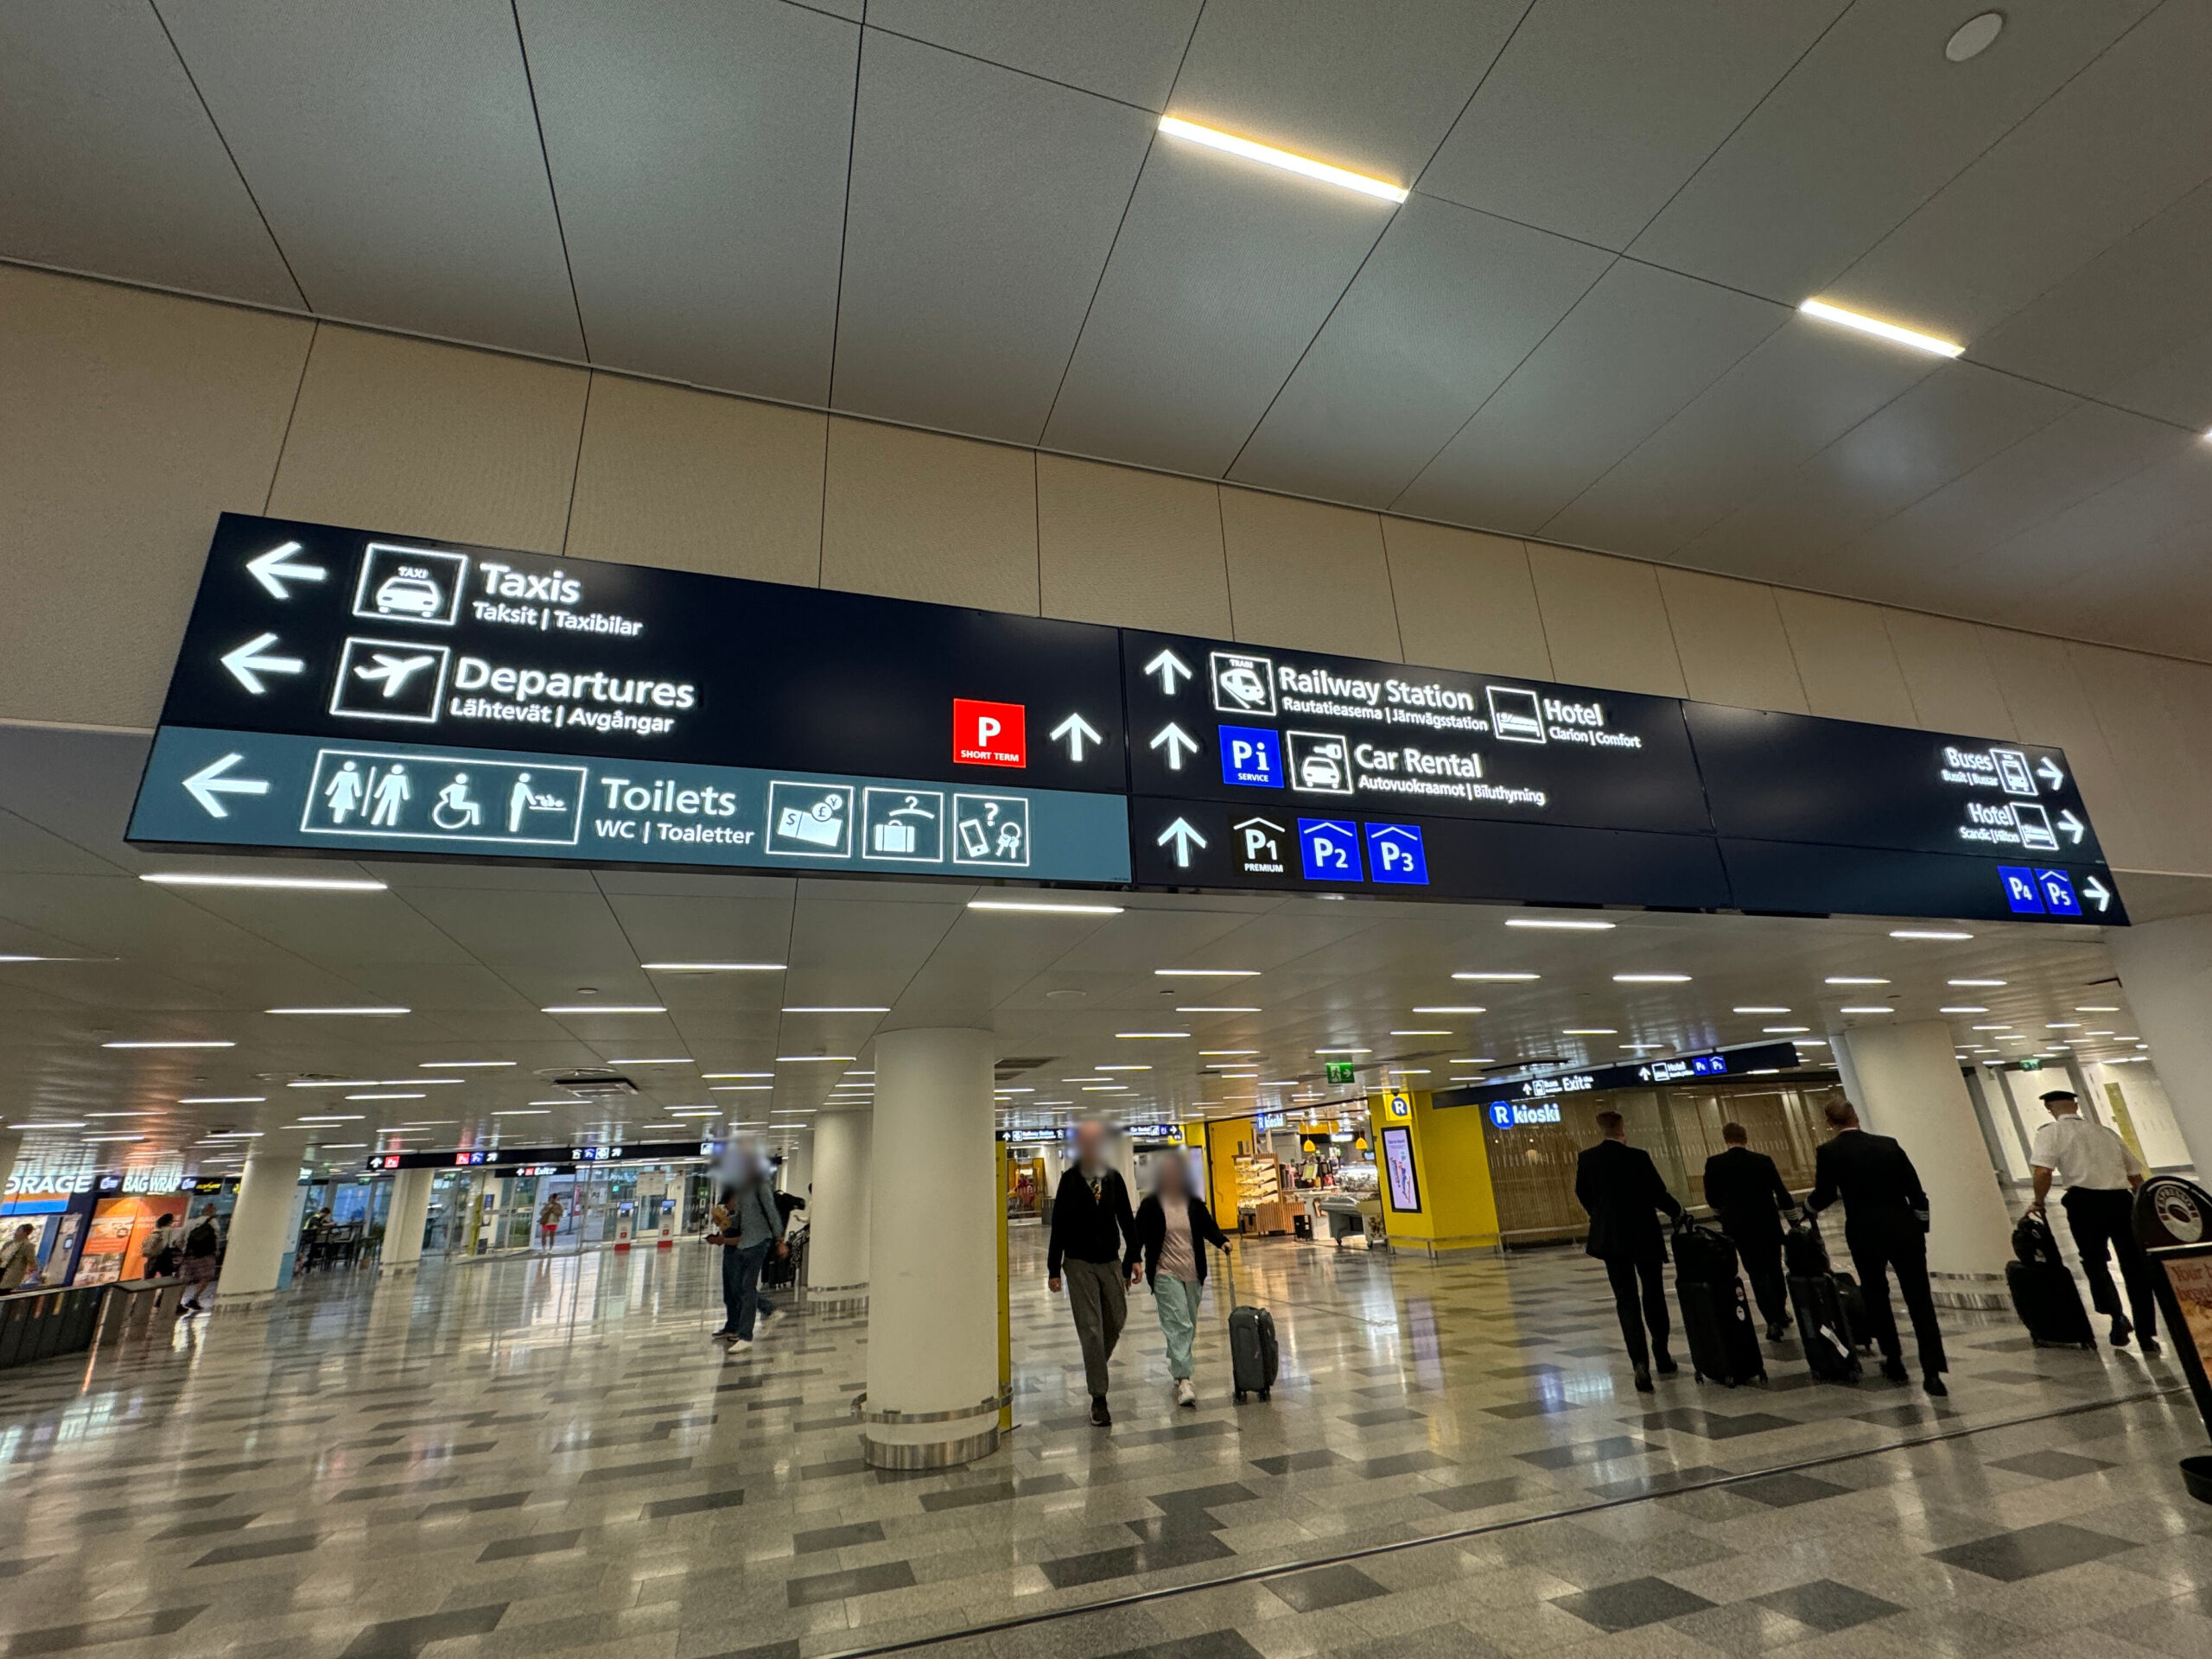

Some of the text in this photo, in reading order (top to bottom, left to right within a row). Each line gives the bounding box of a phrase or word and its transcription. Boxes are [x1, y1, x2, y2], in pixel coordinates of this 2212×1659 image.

[398, 566, 429, 578] TAXI
[480, 563, 582, 604] Taxis
[473, 601, 538, 626] Taksit
[554, 610, 644, 636] Taxibilar
[1230, 658, 1254, 669] TRAIN
[454, 657, 695, 708] Departures
[1278, 667, 1474, 711] Railway Station
[450, 697, 552, 722] Lähtevät
[568, 708, 675, 734] Avgångar
[1282, 697, 1382, 720] Rautatieasema
[1393, 709, 1489, 732] Järnvägsstation
[1543, 698, 1605, 727] Hotel
[978, 716, 1001, 747] P
[1549, 727, 1589, 742] Clarion
[1595, 731, 1643, 748] Comfort
[961, 749, 1020, 762] SHORT TERM
[1354, 743, 1482, 778] Car Rental
[1944, 746, 1994, 772] Buses
[1237, 772, 1269, 783] SERVICE
[1357, 774, 1465, 797] Autovuokraamot
[1473, 784, 1546, 806] Biluthyrning
[601, 778, 737, 816] Toilets
[1967, 802, 2014, 826] Hotel
[594, 819, 635, 838] WC
[657, 823, 755, 844] Toaletter
[1245, 829, 1278, 861] P1
[1313, 837, 1348, 868] P2
[1380, 842, 1414, 873] P3
[1244, 862, 1284, 874] PREMIUM
[2009, 877, 2032, 900] P4
[2046, 882, 2071, 906] P5
[1562, 1076, 1585, 1092] Exit
[1393, 1100, 1406, 1115] R
[1494, 1103, 1560, 1124] R kioski
[122, 1175, 149, 1192] BAG
[149, 1175, 182, 1192] WRAP
